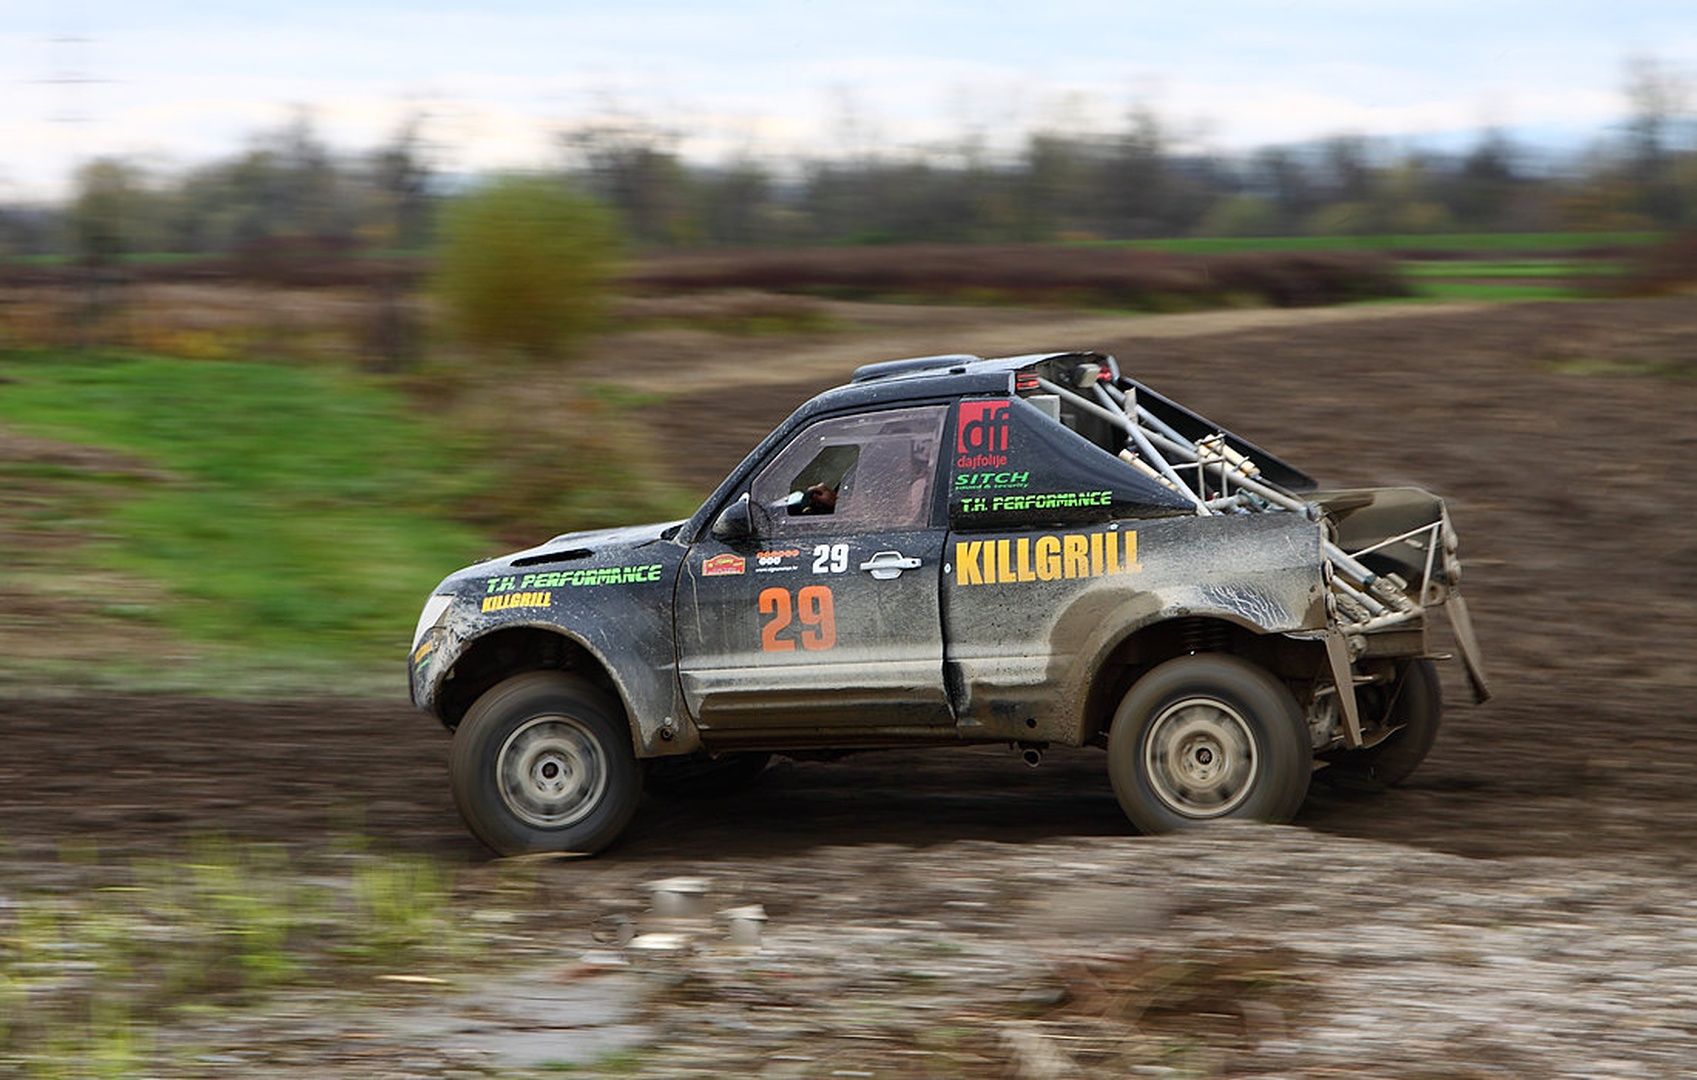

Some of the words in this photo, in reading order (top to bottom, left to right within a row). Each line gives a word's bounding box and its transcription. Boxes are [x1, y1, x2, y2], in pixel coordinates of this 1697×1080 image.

[957, 453, 1007, 470] dajfolije
[955, 471, 1030, 485] SITCH
[992, 491, 1113, 511] PERFORMANCE
[812, 543, 849, 574] 29
[955, 530, 1143, 586] KILLGRILL
[520, 564, 662, 589] PERFORMANCE
[481, 591, 552, 613] KILLGRILL
[758, 585, 837, 652] 29
